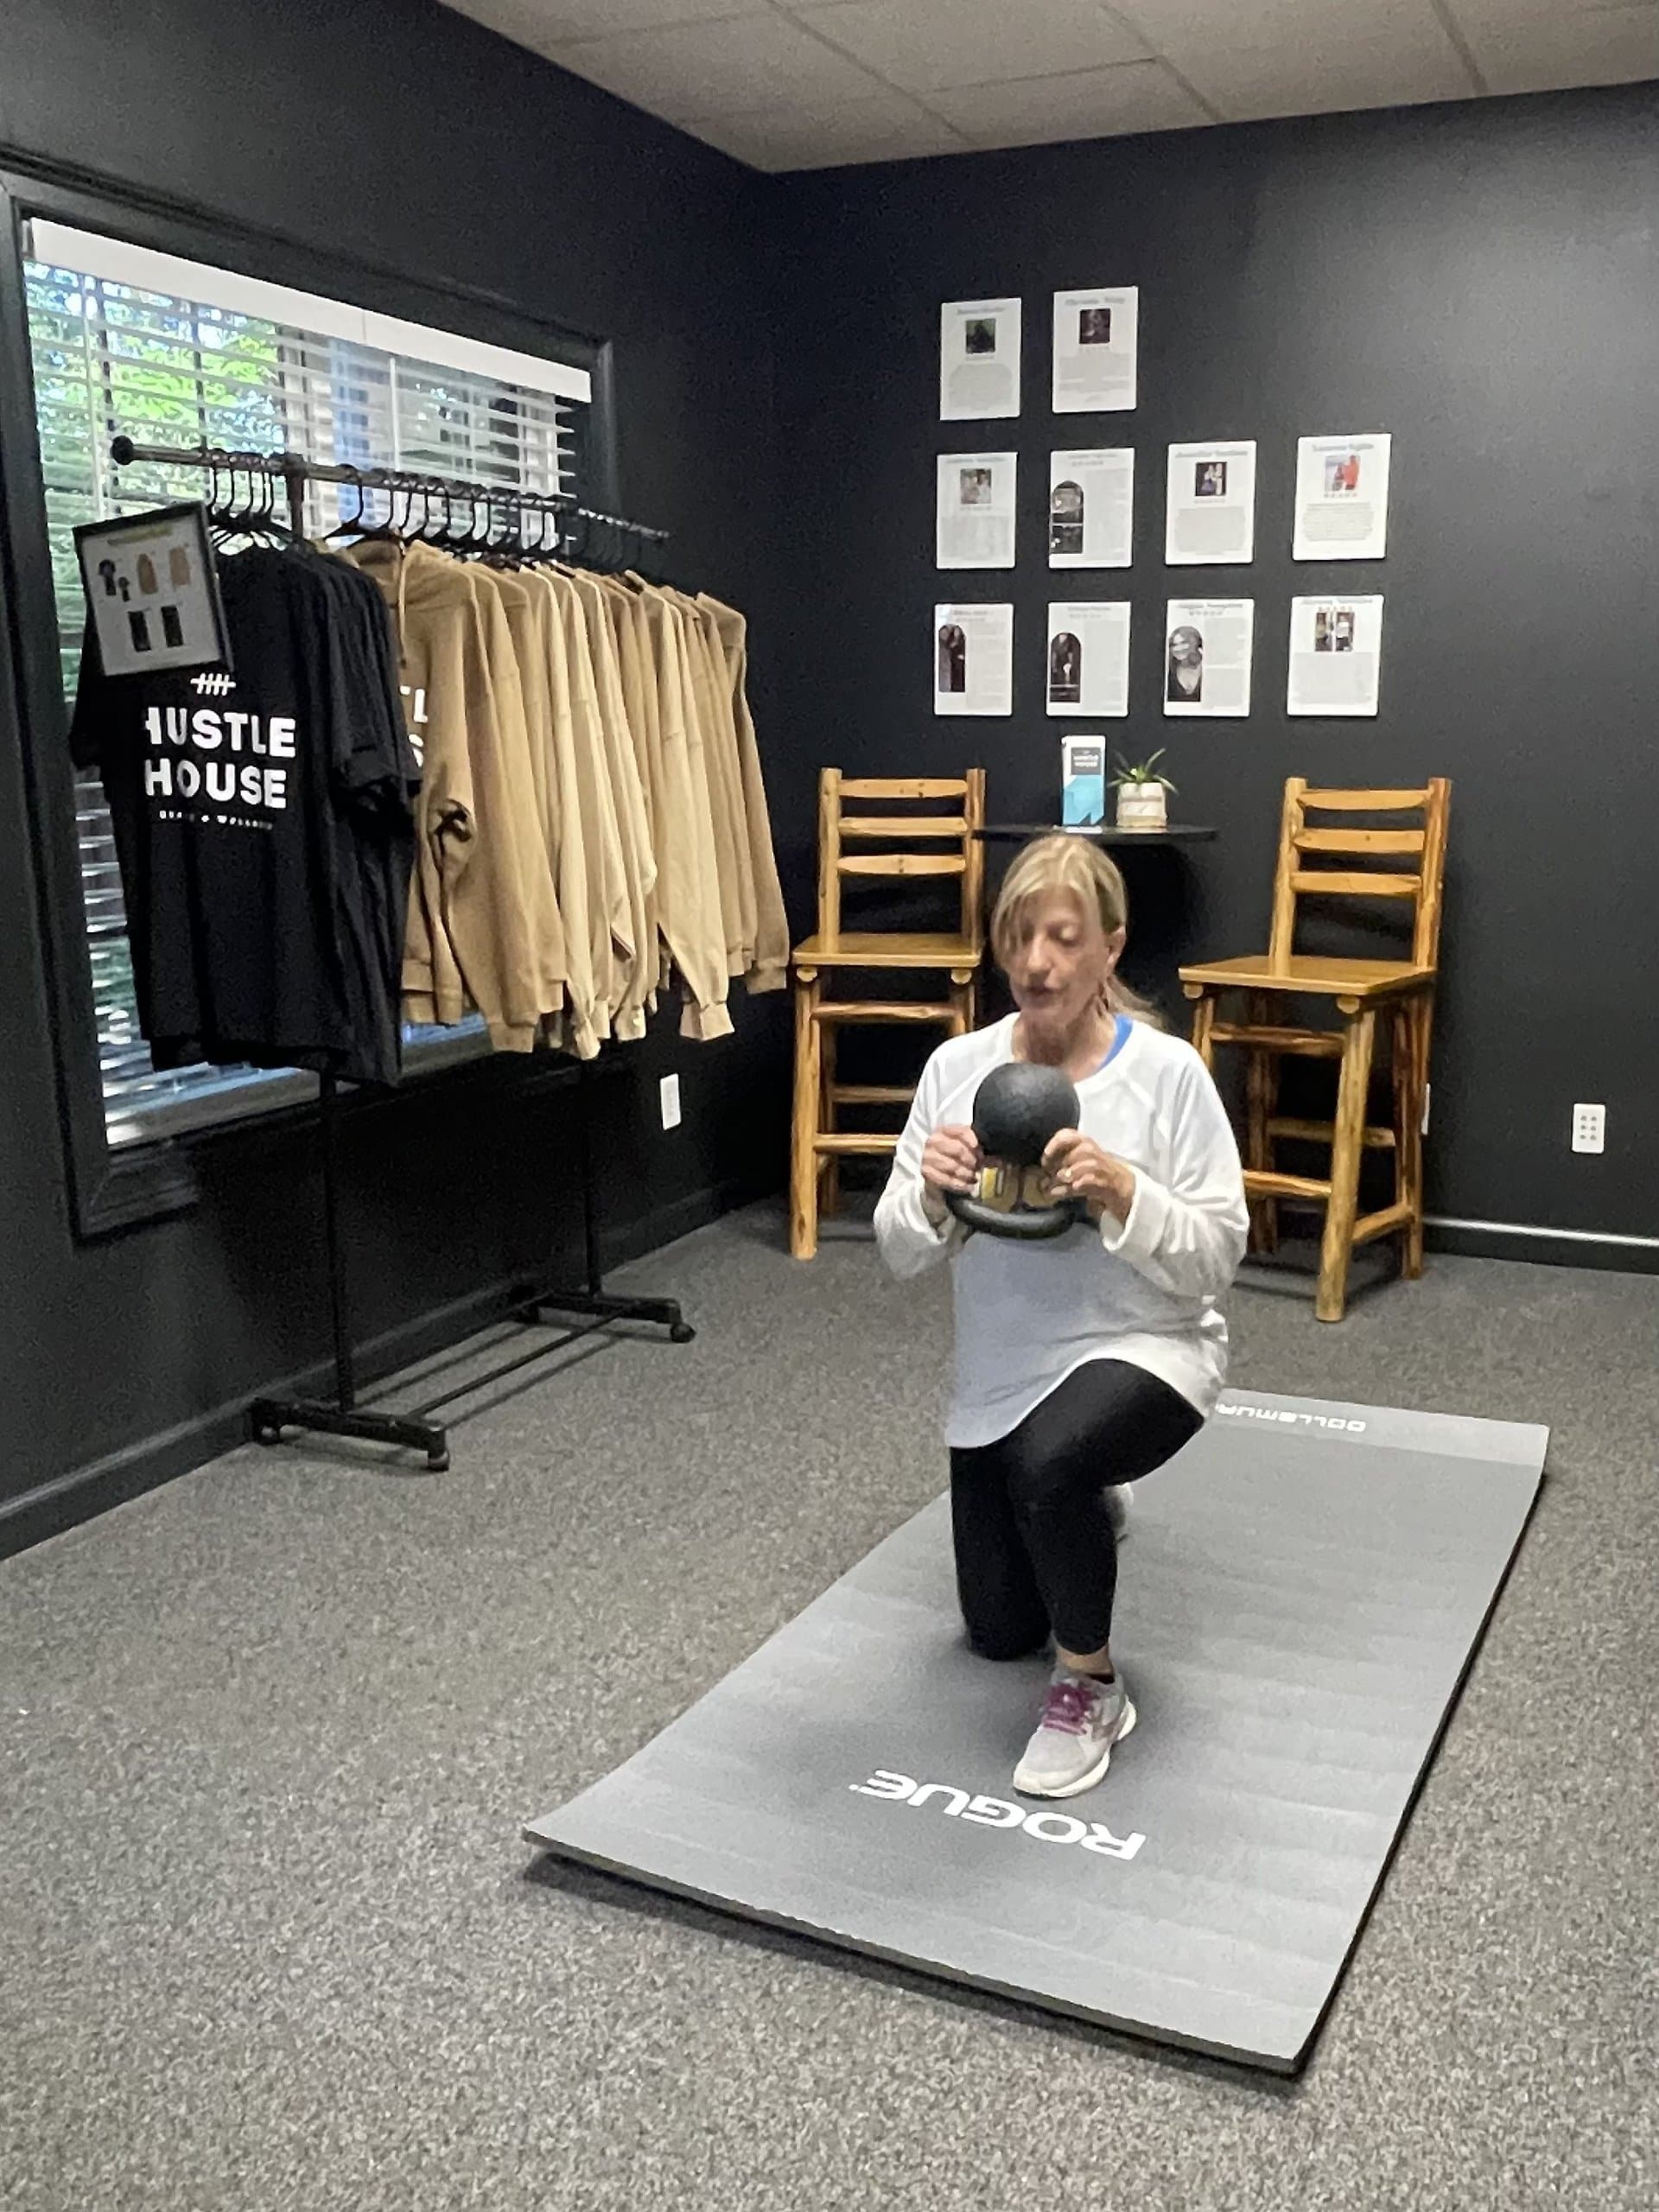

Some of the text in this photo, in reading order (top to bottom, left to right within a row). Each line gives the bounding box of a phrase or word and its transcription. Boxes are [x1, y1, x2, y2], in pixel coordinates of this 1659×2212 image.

[144, 706, 296, 759] HUSTLE
[143, 758, 288, 809] HOUSE
[857, 1770, 1147, 1860] ROGUE
